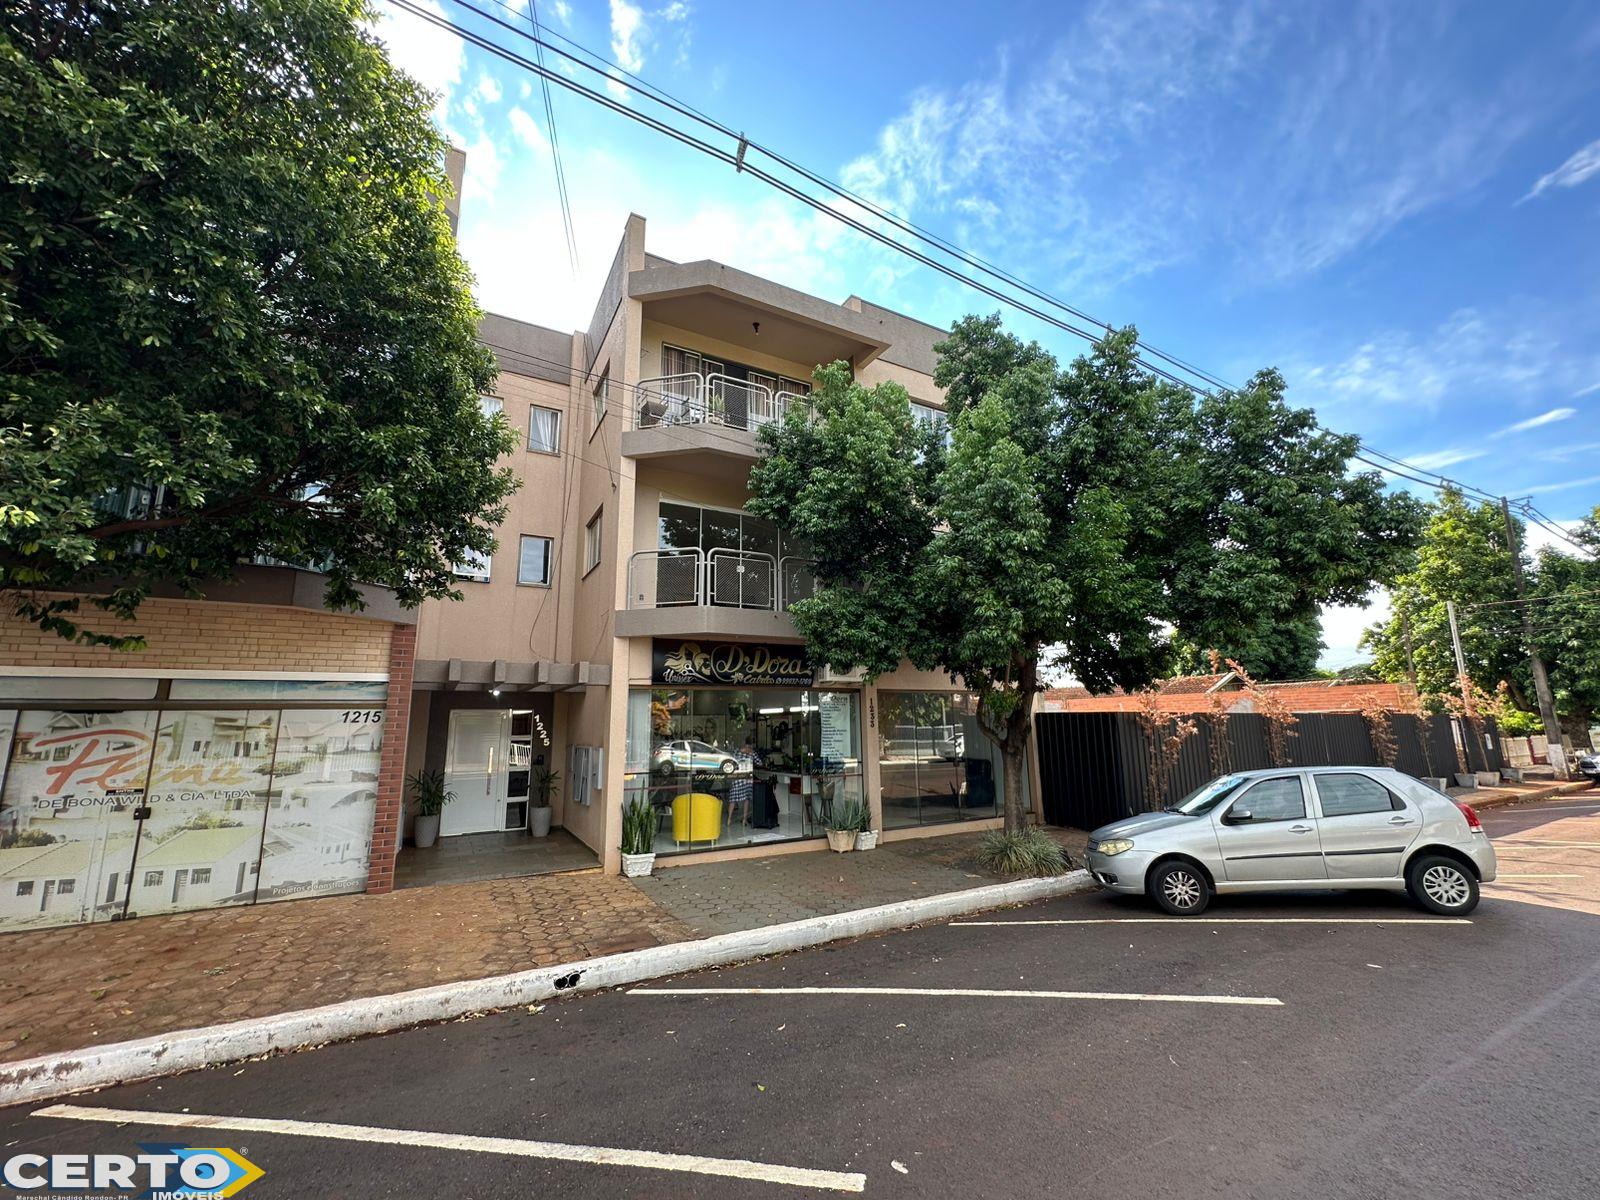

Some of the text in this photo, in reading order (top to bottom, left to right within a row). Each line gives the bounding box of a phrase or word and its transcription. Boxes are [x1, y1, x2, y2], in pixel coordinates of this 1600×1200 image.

[342, 710, 382, 723] 1215
[534, 714, 550, 747] 1225
[38, 798, 62, 809] DE
[67, 795, 116, 807] BONA
[121, 794, 161, 806] WID
[165, 793, 175, 802] &
[272, 884, 306, 896] Projetos
